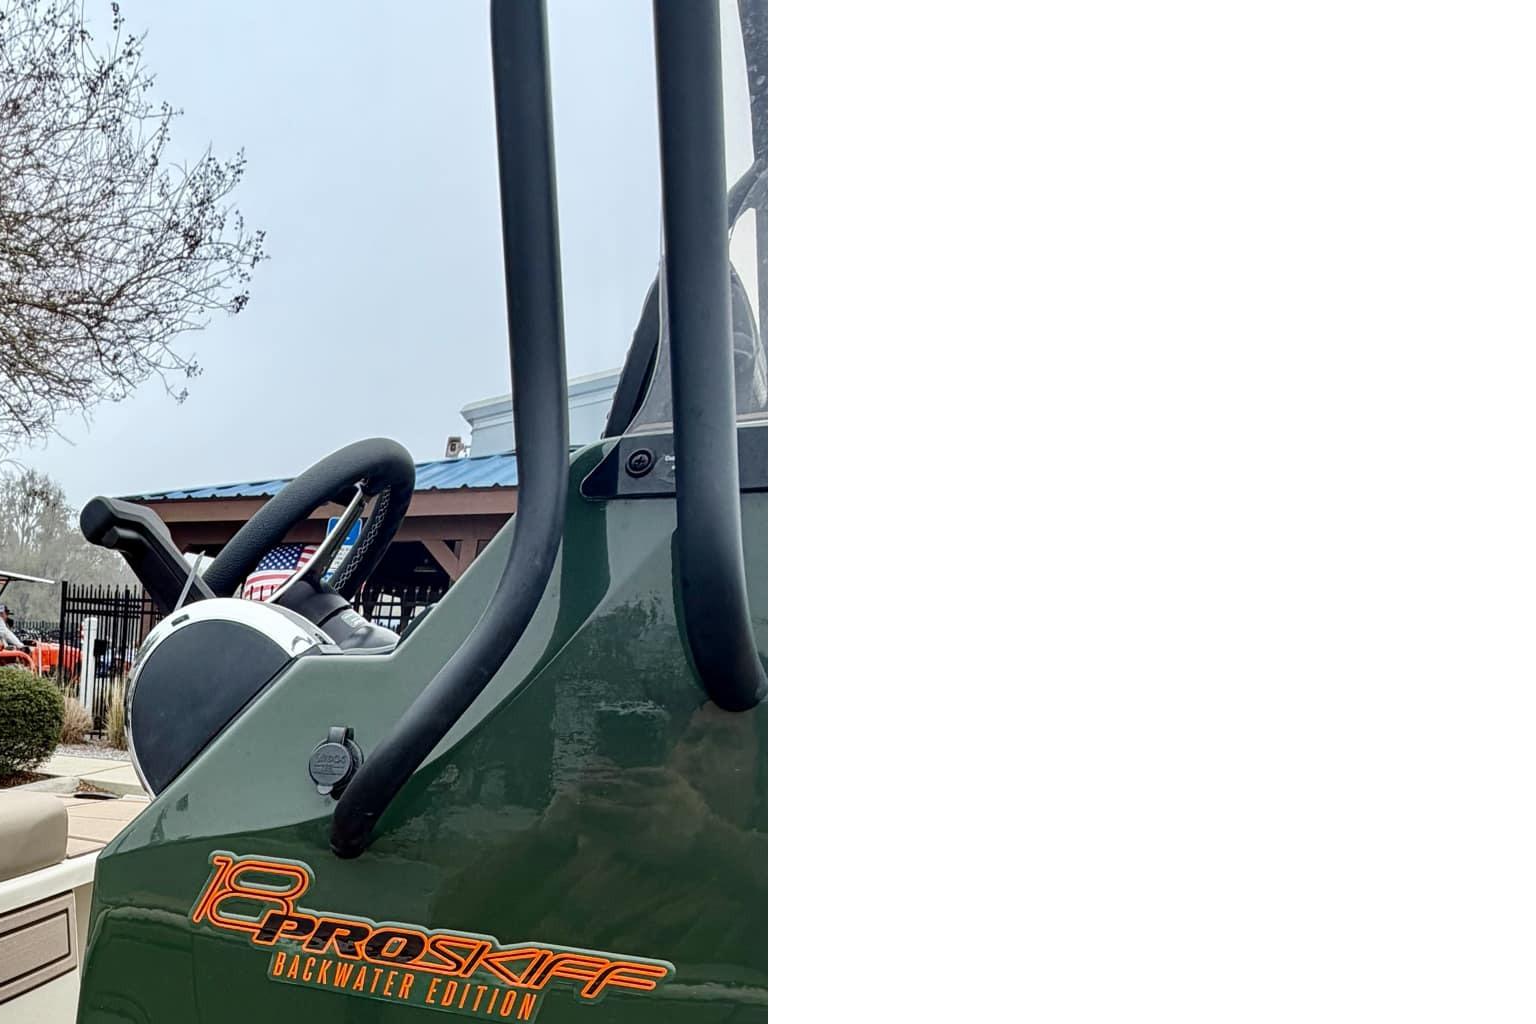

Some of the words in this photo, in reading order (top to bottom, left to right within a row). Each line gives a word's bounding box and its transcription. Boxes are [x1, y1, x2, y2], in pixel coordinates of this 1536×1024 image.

[192, 855, 310, 933] 18
[272, 951, 413, 1000] BACKWATER
[425, 981, 539, 1022] EDITION
